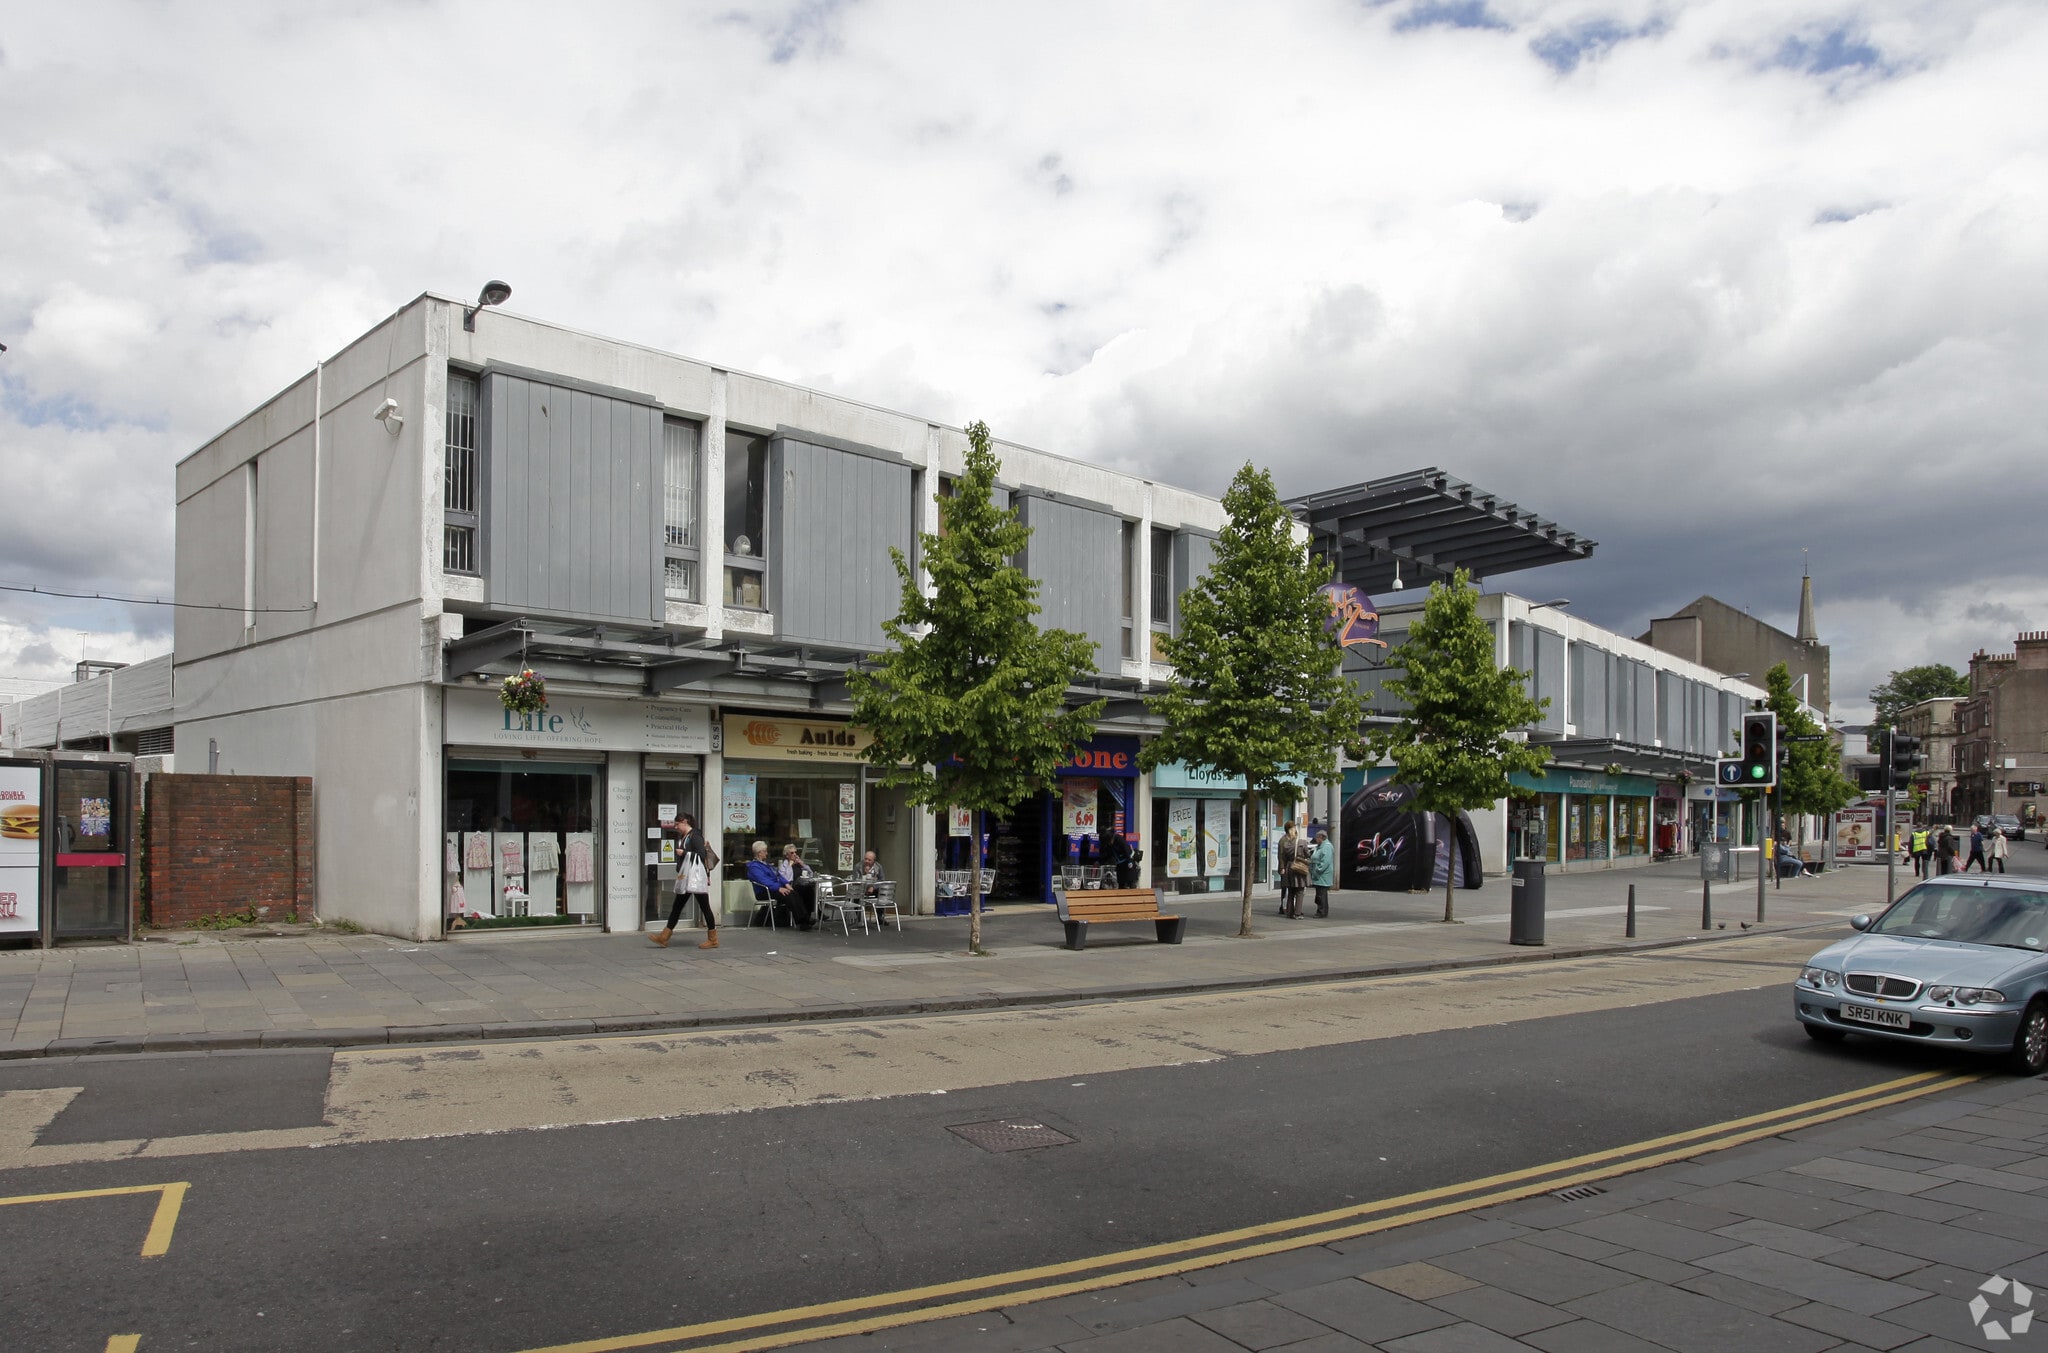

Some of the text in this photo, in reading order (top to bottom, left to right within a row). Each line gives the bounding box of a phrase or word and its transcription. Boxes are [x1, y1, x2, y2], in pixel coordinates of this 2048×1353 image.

[501, 703, 564, 734] Life
[650, 723, 674, 731] Practical
[494, 732, 522, 741] LOVING
[800, 727, 856, 747] Aulds
[798, 749, 813, 757] baking
[1378, 790, 1404, 803] sky
[1075, 810, 1094, 826] 6.99
[1172, 807, 1192, 823] FREE
[1841, 813, 1855, 821] BBQ
[1357, 832, 1405, 862] sky
[1847, 1005, 1903, 1025] SR51 KNK
